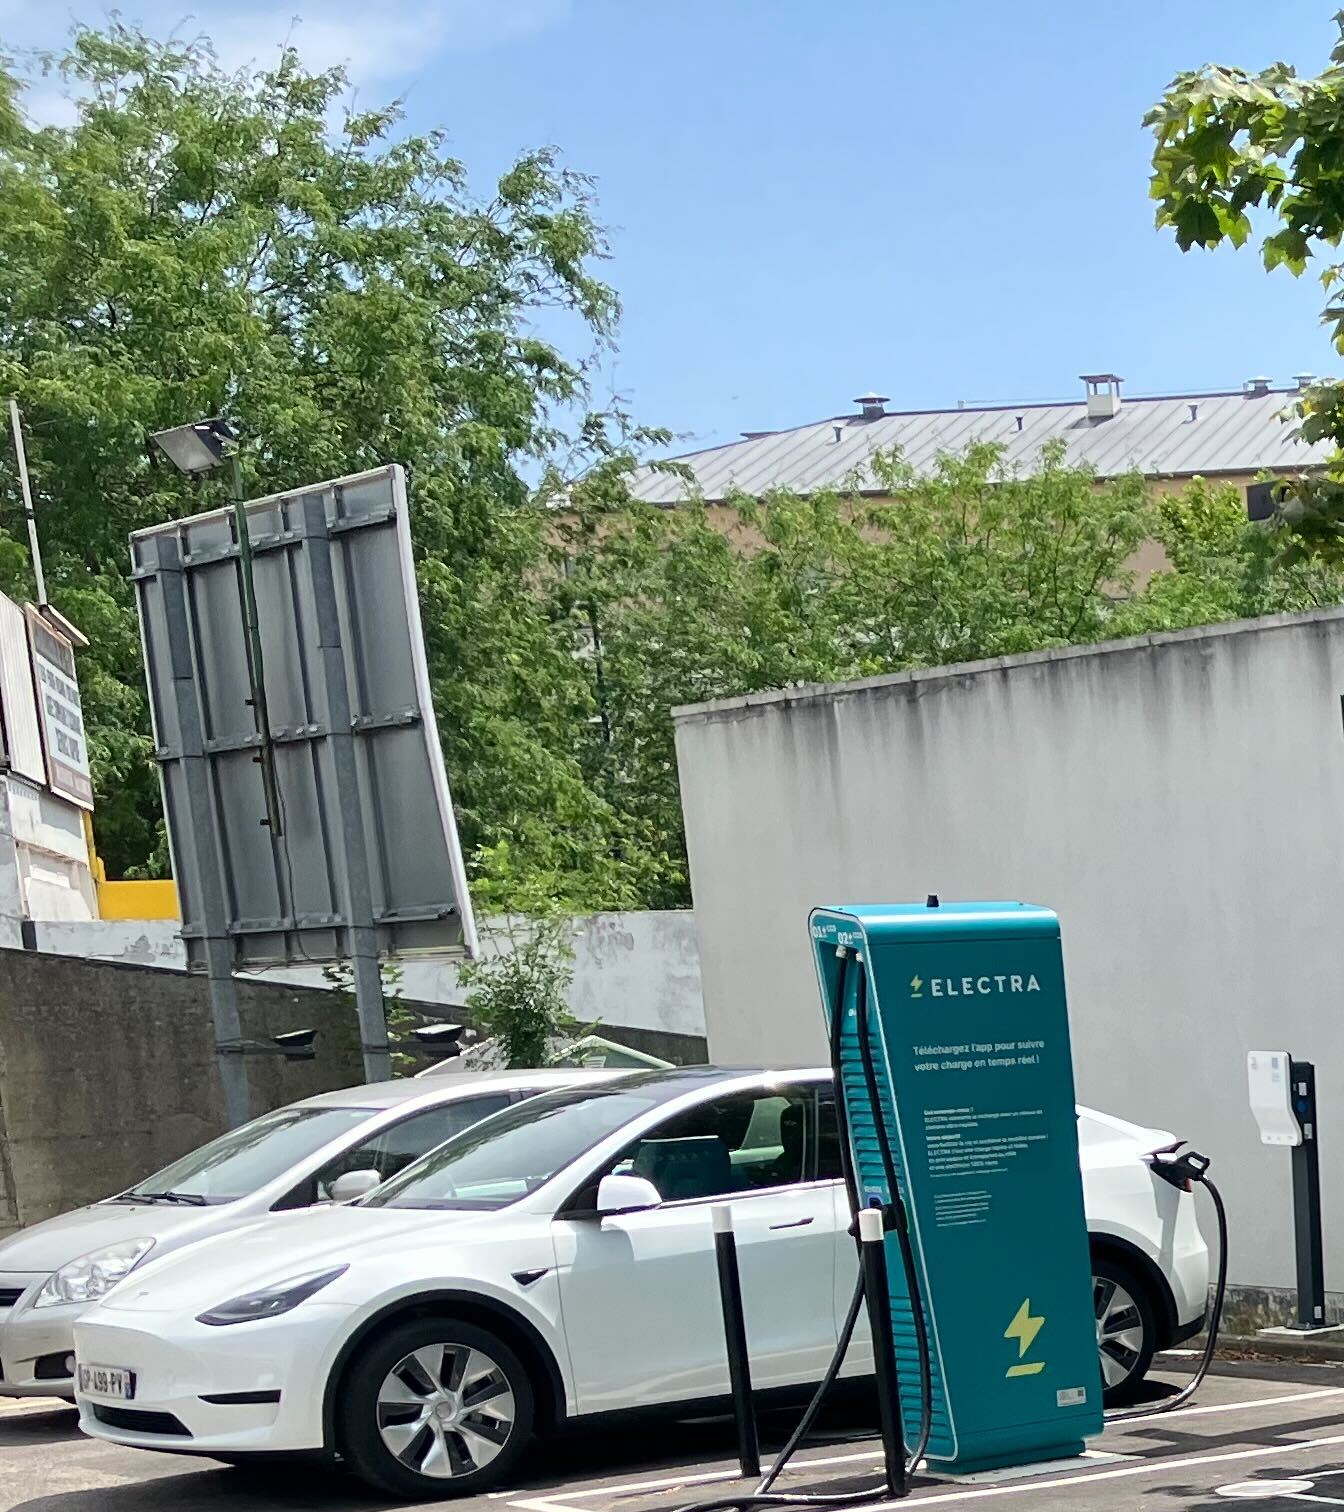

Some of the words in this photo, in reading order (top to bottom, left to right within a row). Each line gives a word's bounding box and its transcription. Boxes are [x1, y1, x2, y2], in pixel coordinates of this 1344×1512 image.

[931, 975, 1040, 997] ELECTRA
[994, 1042, 1015, 1052] pour
[1017, 1040, 1045, 1049] suivre
[914, 1062, 939, 1071] votre
[940, 1060, 973, 1071] charge
[987, 1058, 1016, 1067] temps
